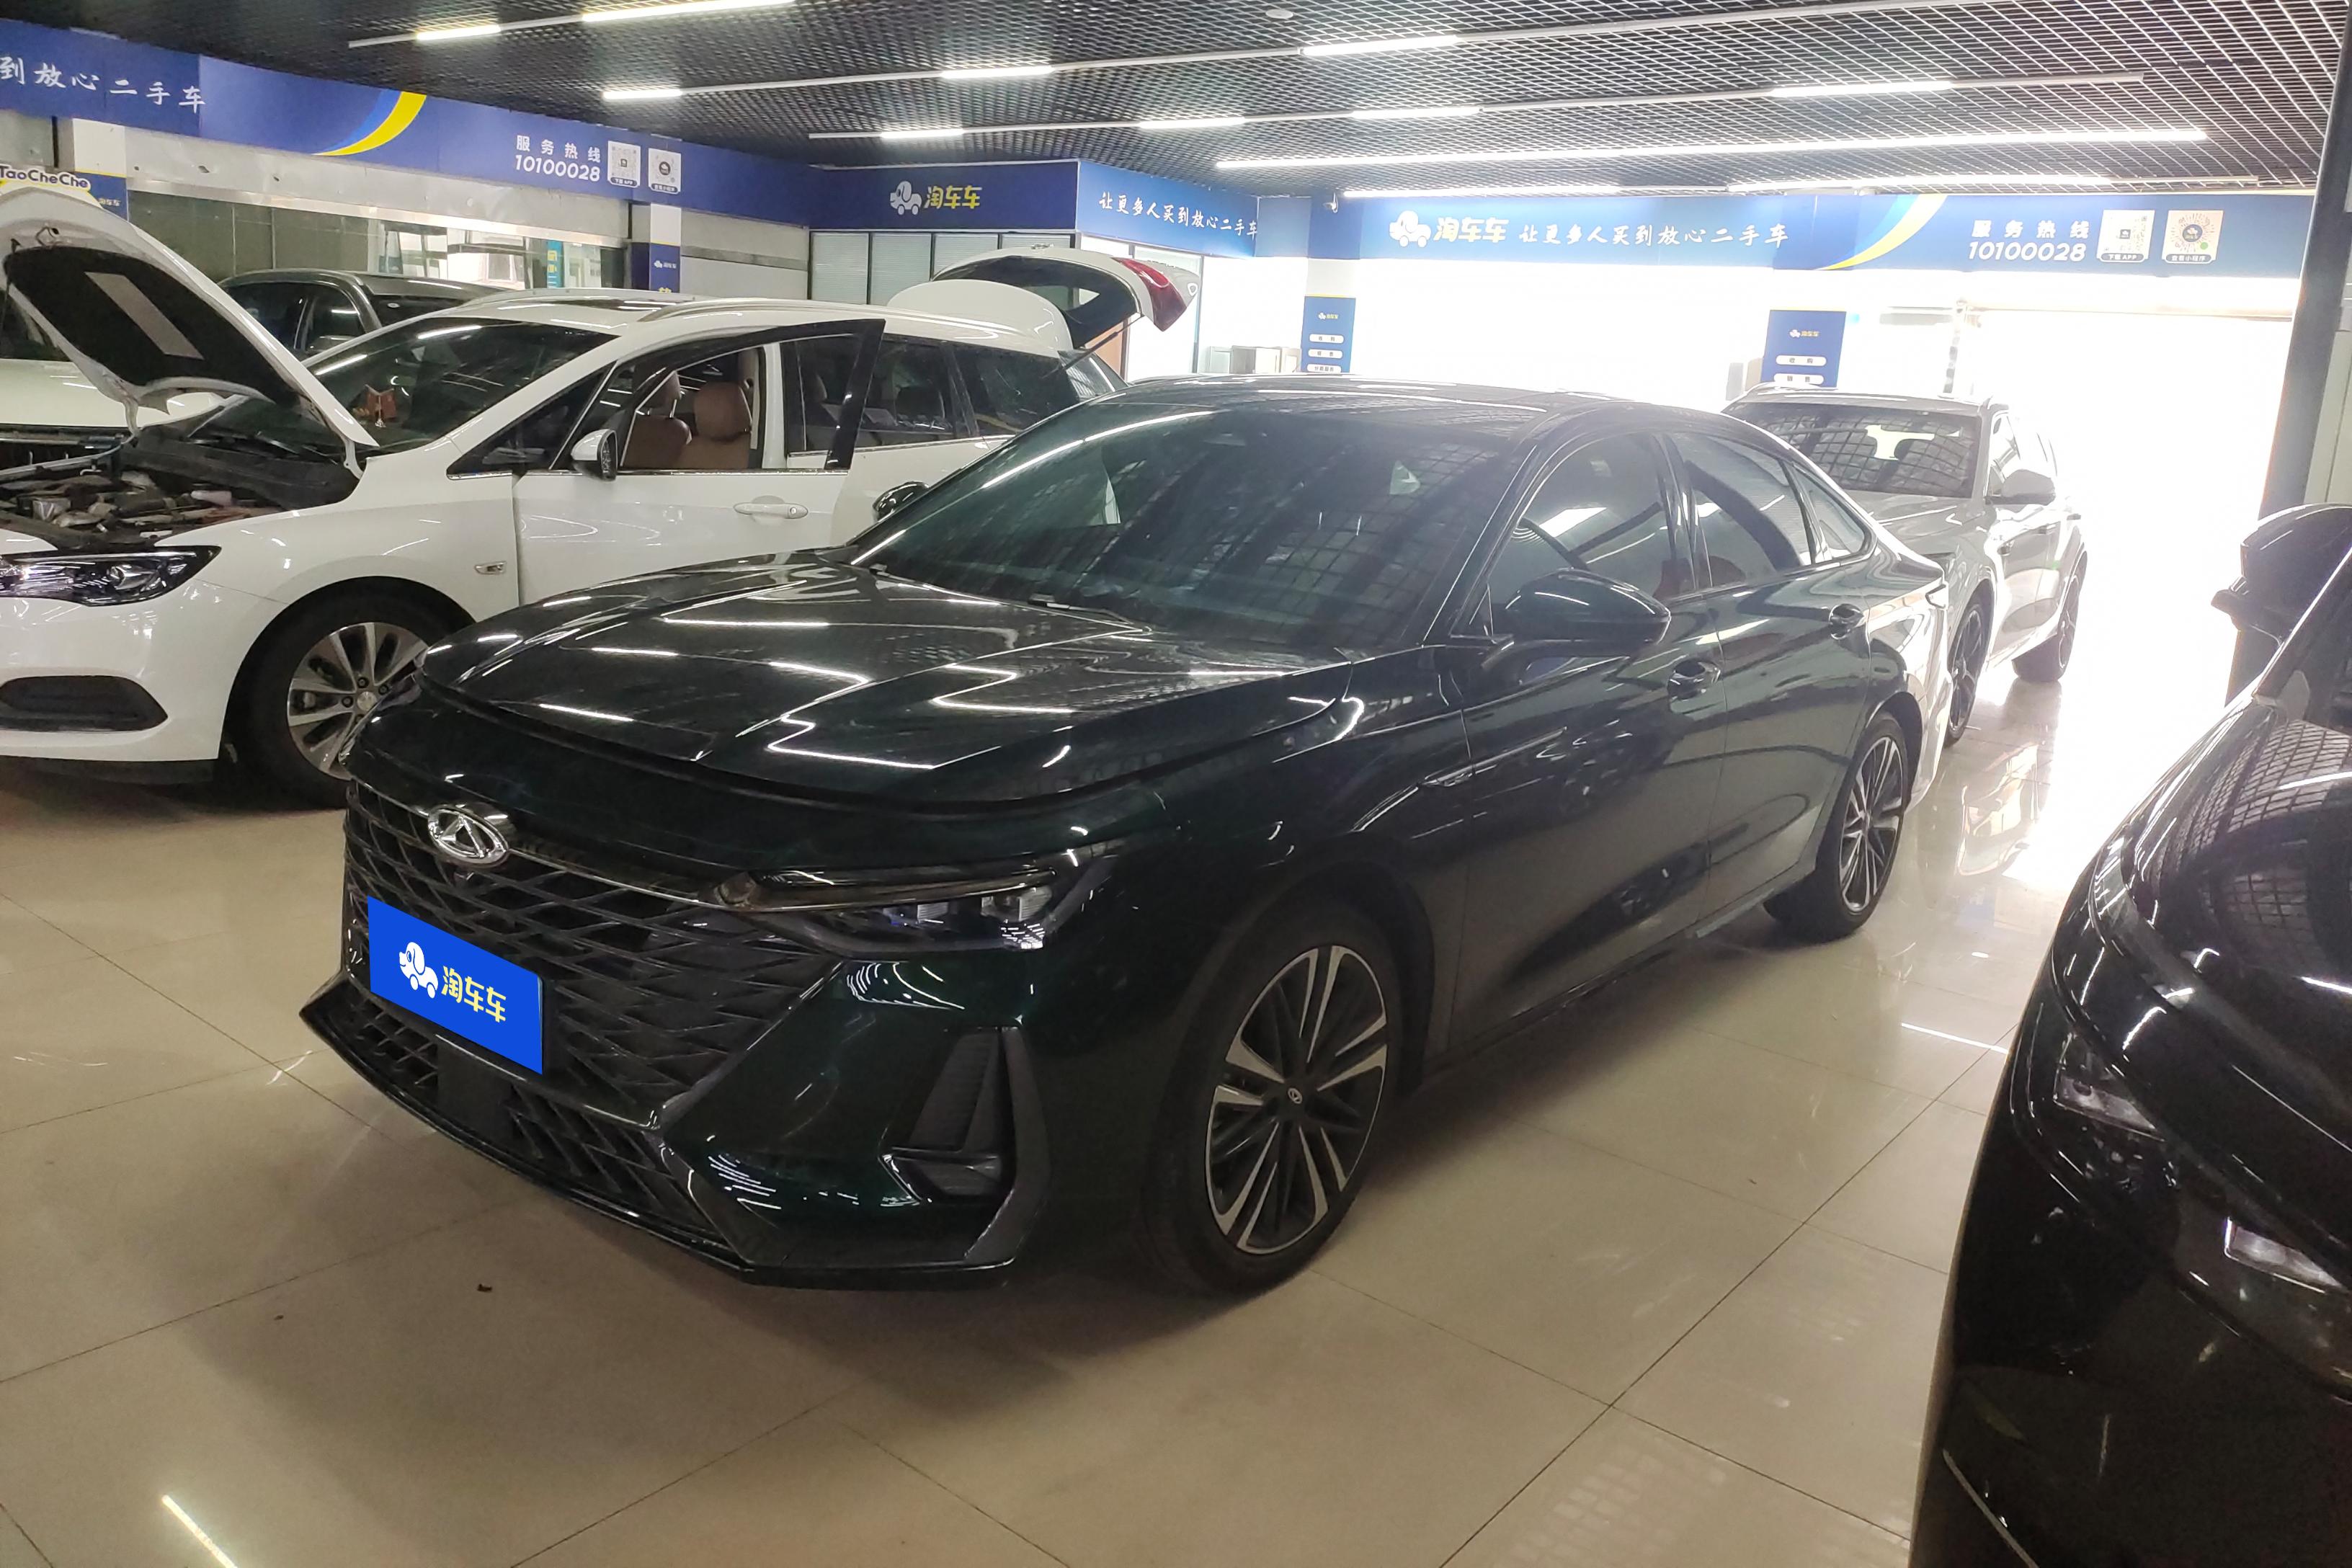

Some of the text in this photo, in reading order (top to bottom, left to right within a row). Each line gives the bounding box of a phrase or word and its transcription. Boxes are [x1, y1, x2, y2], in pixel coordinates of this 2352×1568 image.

[0, 56, 206, 113] 到放心二手车
[516, 135, 601, 164] 服务热线
[0, 165, 89, 189] TaoCheChe
[514, 154, 601, 182] 10100028
[923, 184, 983, 209] 淘车车
[1098, 191, 1258, 241] 让更多人买到放心二手车
[1972, 220, 2090, 239] 服务热线
[1433, 216, 1788, 249] 淘车车 让更多人买到放心二手车
[1969, 241, 2087, 262] 10100028
